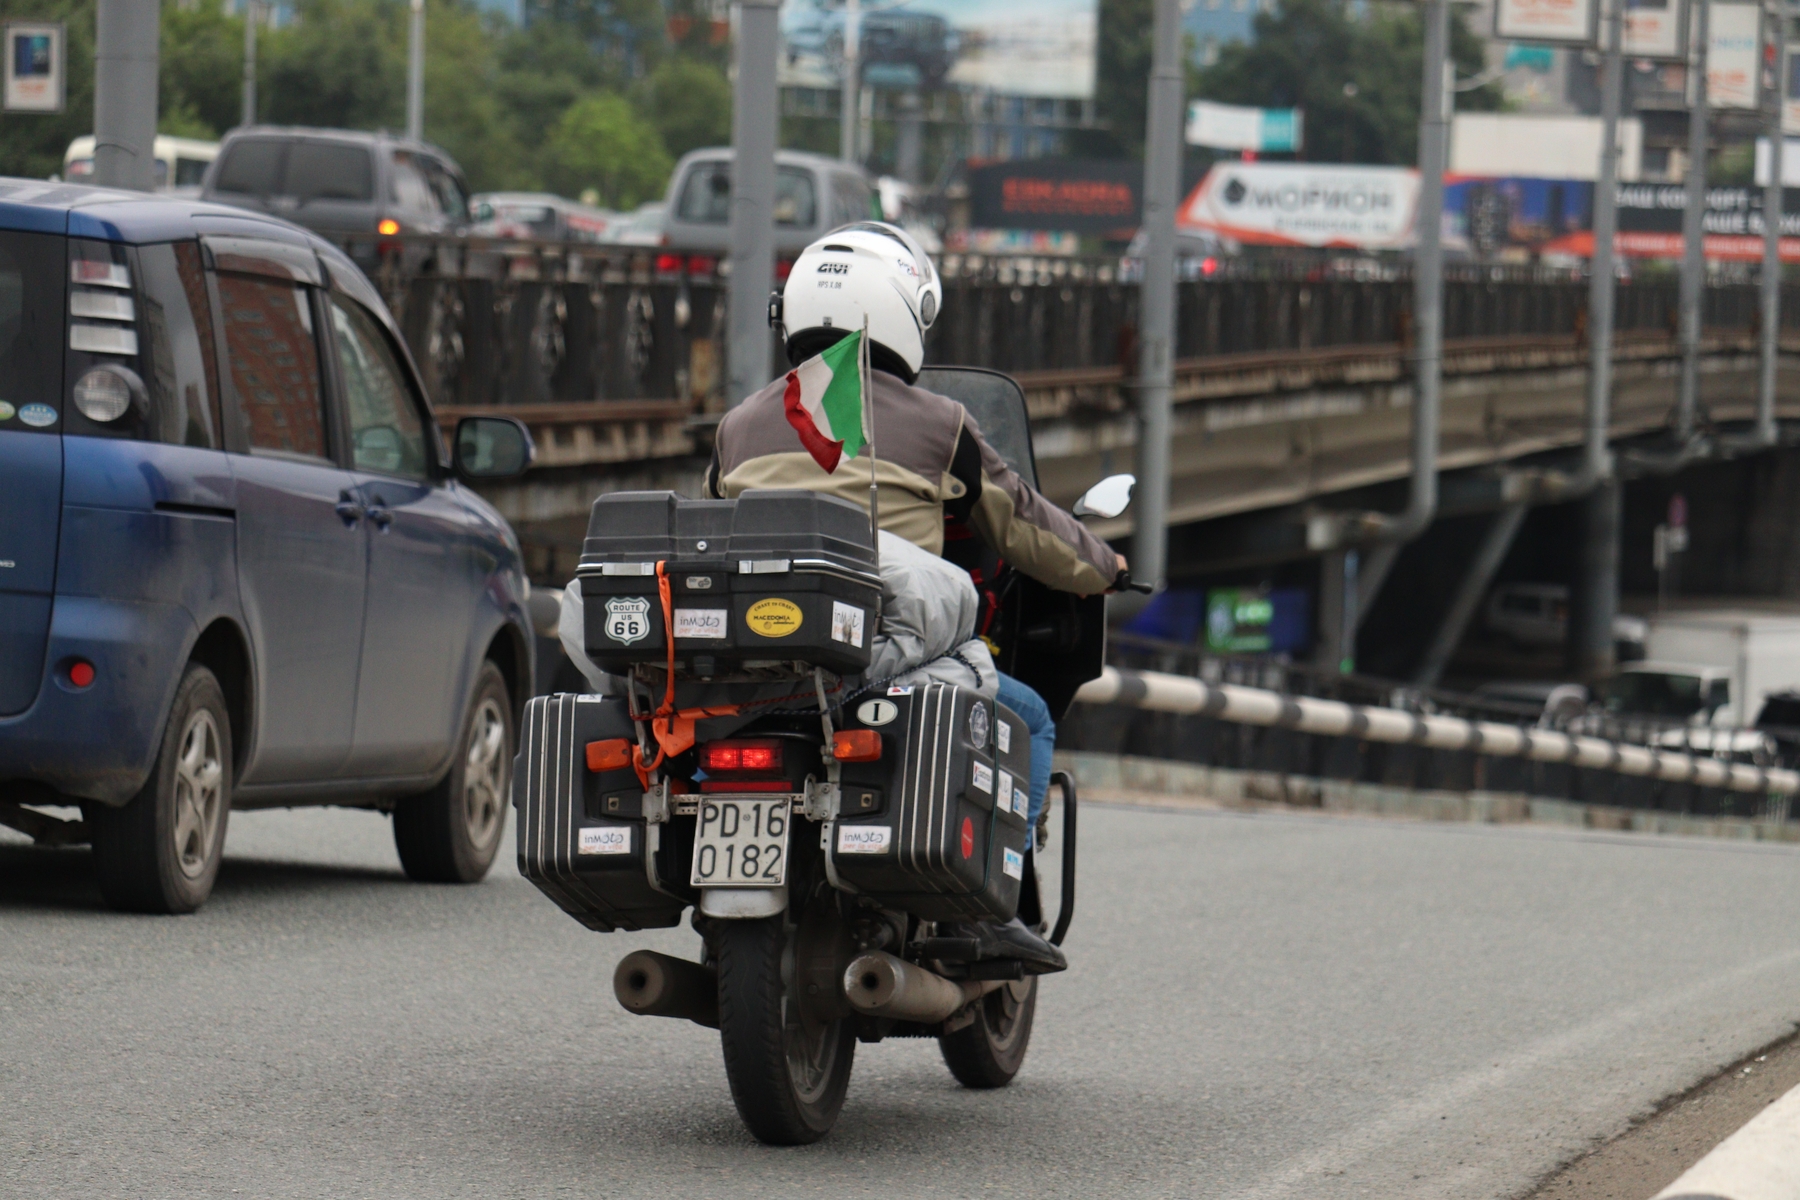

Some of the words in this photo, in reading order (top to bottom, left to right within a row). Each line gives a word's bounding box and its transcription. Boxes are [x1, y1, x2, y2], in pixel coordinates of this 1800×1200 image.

[817, 263, 849, 275] GIVI
[613, 604, 640, 612] ROUTE
[614, 621, 639, 636] 66
[873, 703, 880, 721] I
[698, 844, 782, 878] 0182
